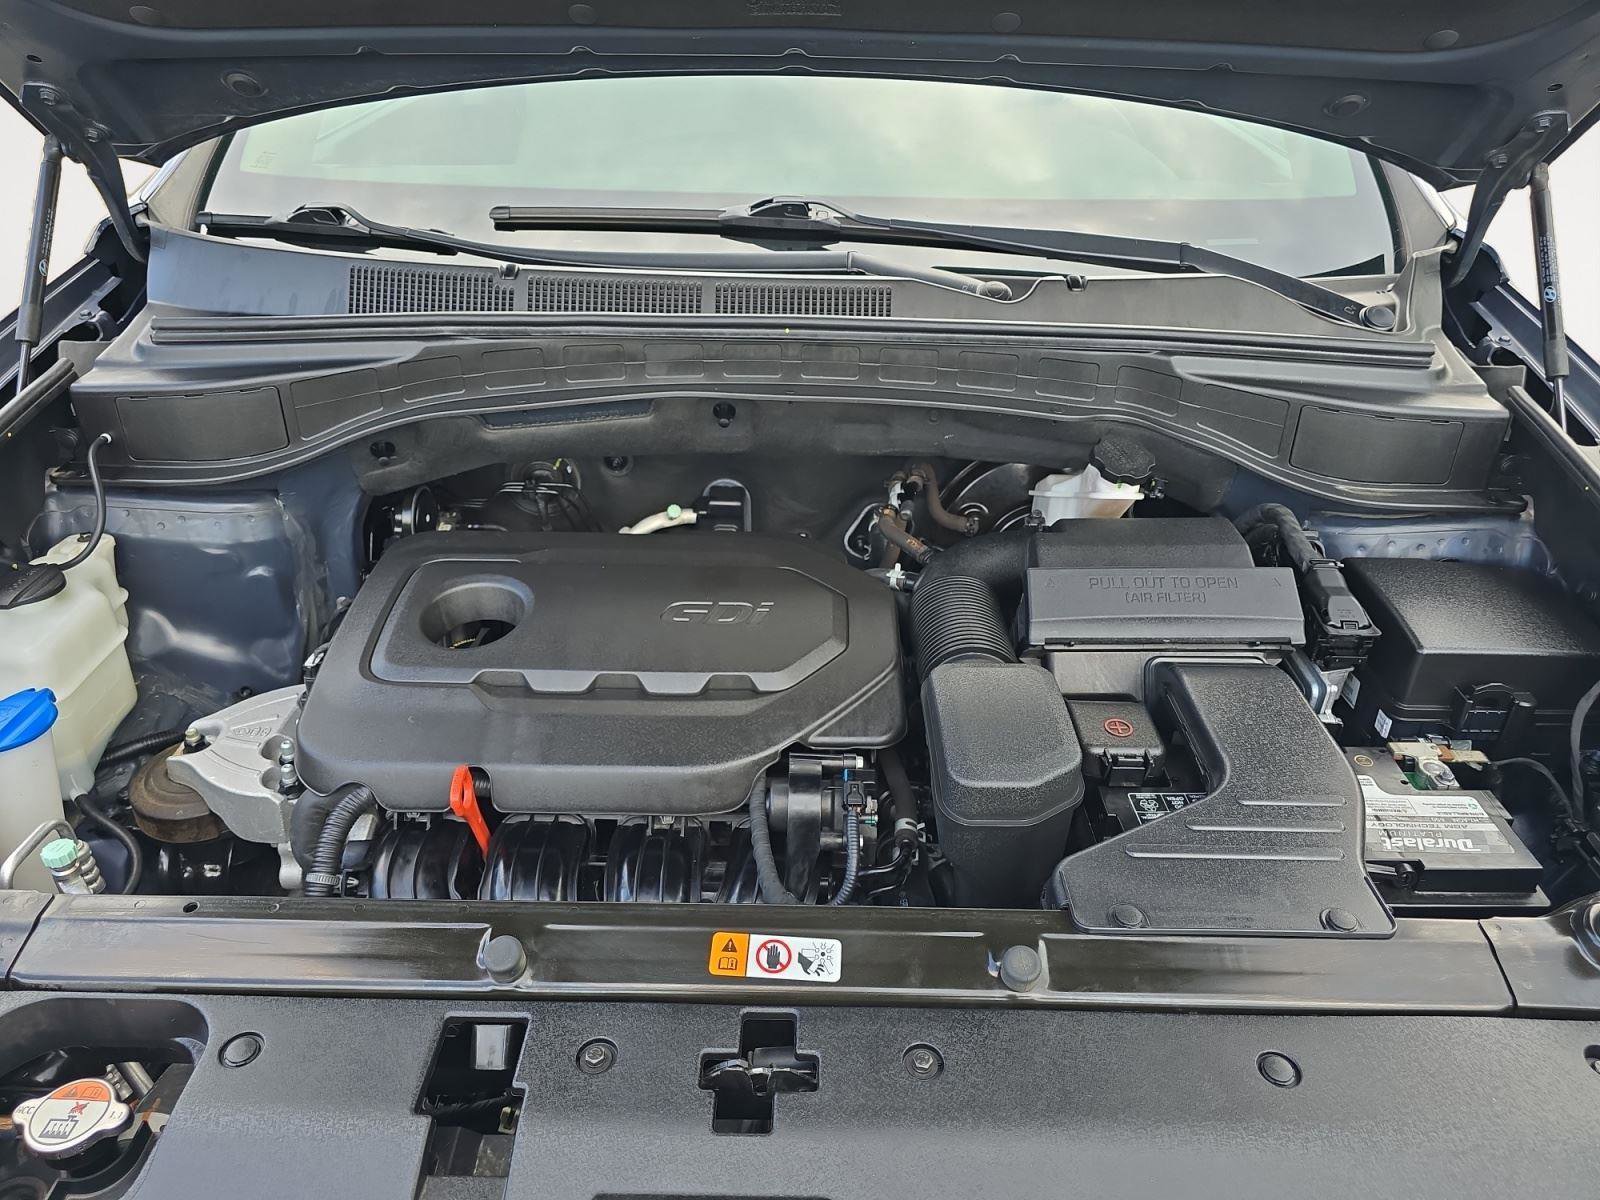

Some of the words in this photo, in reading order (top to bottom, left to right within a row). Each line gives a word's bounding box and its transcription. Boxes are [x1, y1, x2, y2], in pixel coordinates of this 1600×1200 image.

[1088, 576, 1129, 589] PULL
[1133, 576, 1165, 588] OUT
[1170, 576, 1191, 588] TO
[1195, 576, 1239, 588] OPEN
[660, 600, 774, 624] GDi
[1378, 830, 1442, 838] PLATINUM
[1380, 836, 1482, 851] Duralast
